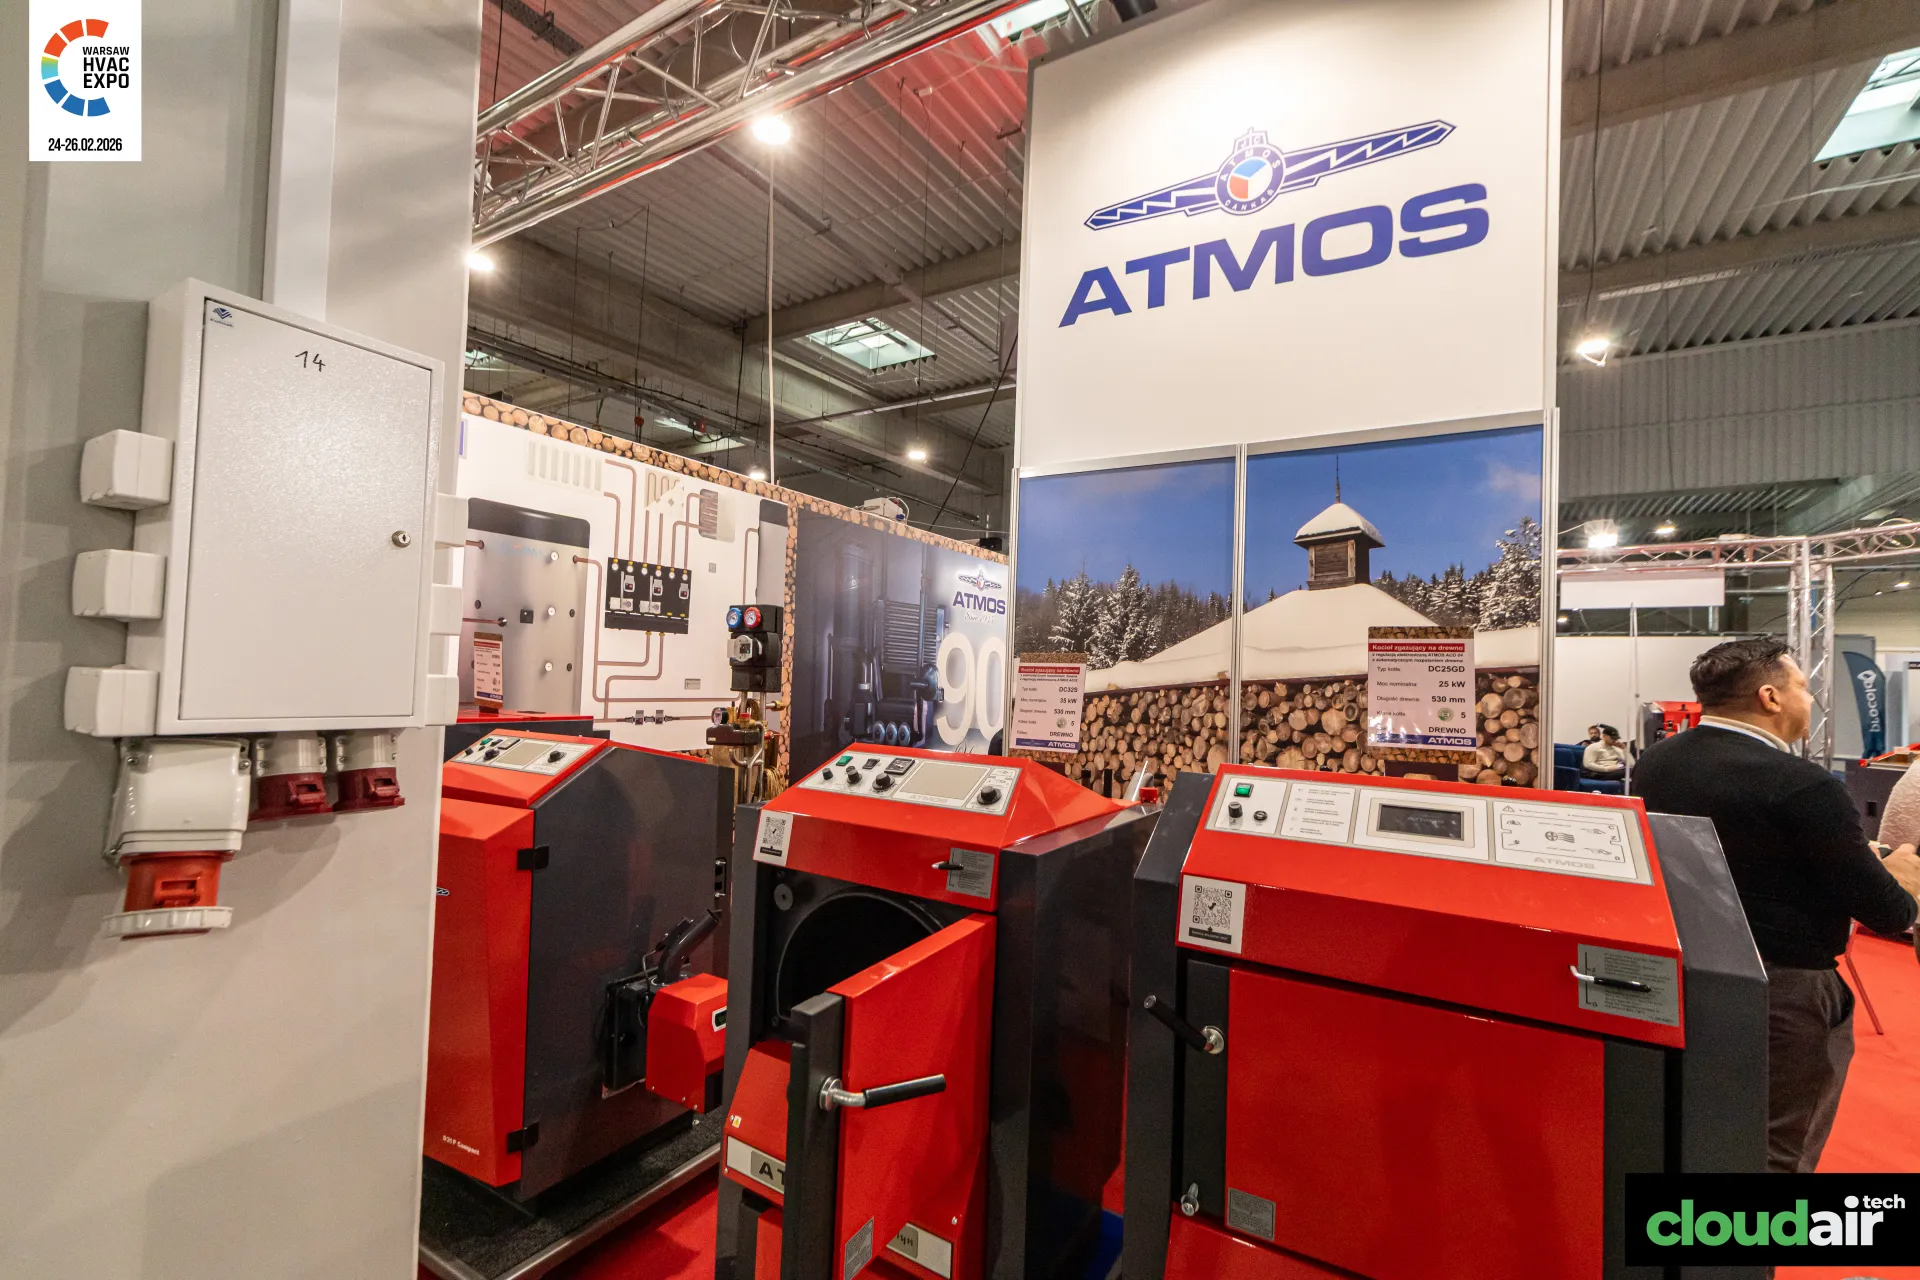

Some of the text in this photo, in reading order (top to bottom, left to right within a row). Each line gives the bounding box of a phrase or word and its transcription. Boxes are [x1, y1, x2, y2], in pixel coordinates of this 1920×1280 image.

[1219, 148, 1281, 182] ATMOS
[1058, 182, 1490, 328] ATMOS
[294, 350, 326, 373] 14
[952, 591, 1006, 615] ATMOS
[1428, 665, 1465, 673] DC25GD
[936, 631, 1006, 746] 90
[1438, 680, 1450, 688] 25
[1451, 680, 1466, 688] kW
[1431, 695, 1447, 703] 530
[1460, 711, 1467, 719] 5
[1428, 726, 1467, 734] DREWNO
[1047, 741, 1077, 749] ATMOS
[1427, 737, 1472, 746] ATMOS
[1534, 857, 1598, 870] ATMOS
